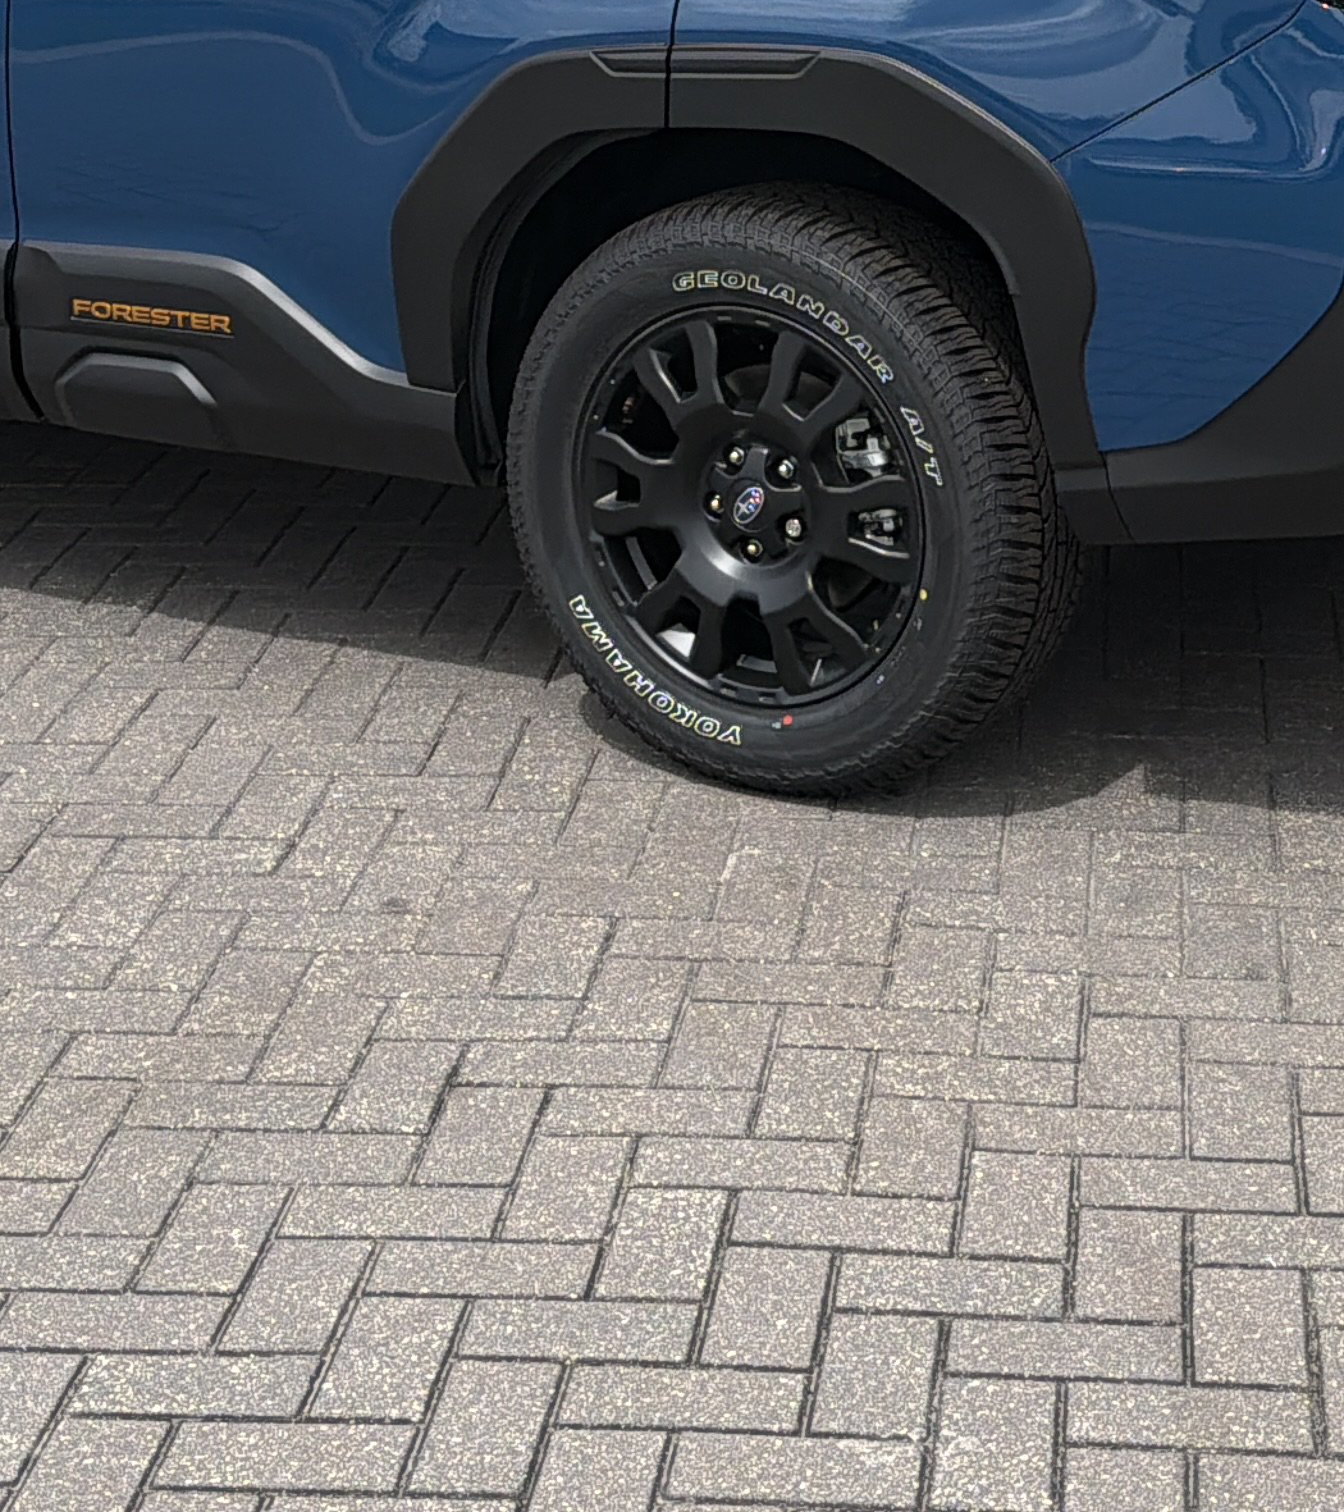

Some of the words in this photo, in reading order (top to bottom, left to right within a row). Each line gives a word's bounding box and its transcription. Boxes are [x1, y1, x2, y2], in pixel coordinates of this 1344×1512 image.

[72, 298, 232, 334] FORESTER
[672, 268, 894, 384] GEOLANDAR
[899, 405, 944, 487] A/T
[569, 594, 743, 747] YOKOHAMA
